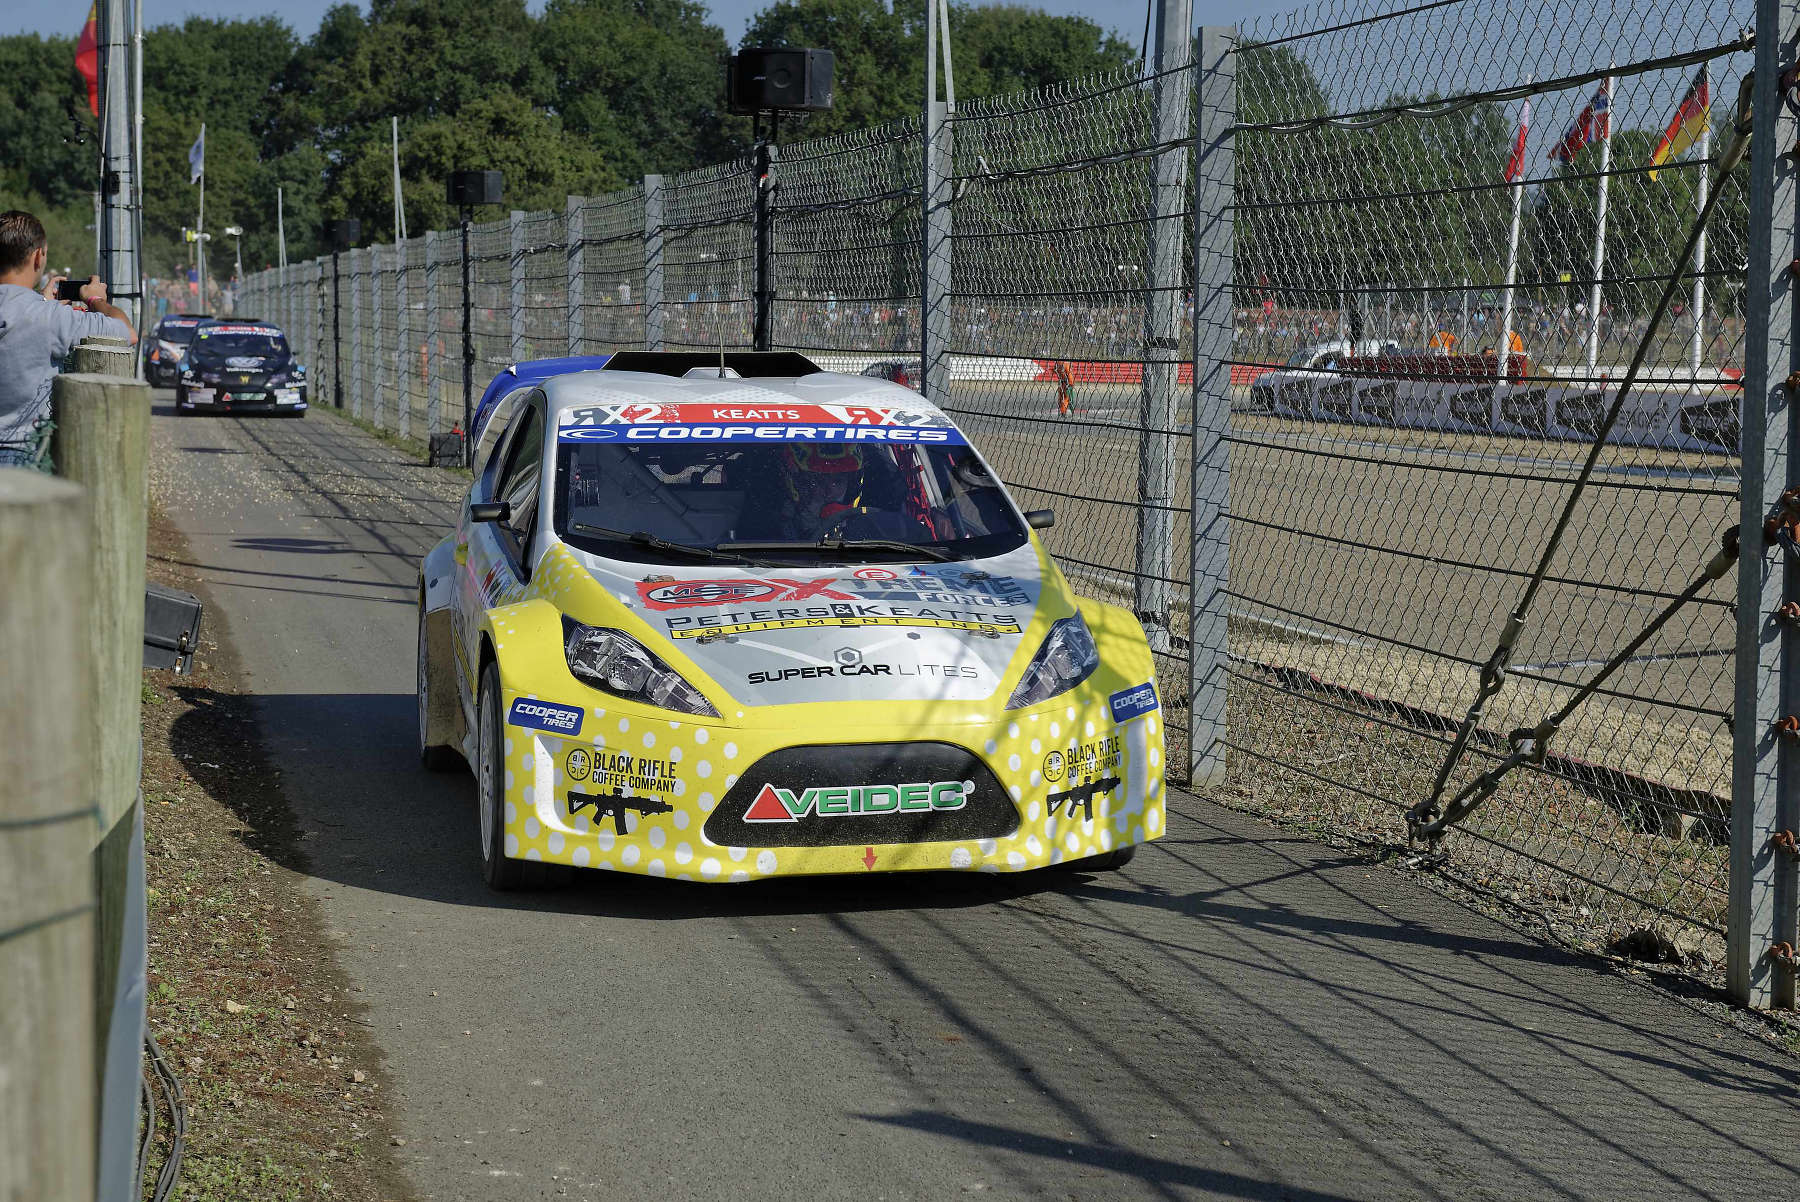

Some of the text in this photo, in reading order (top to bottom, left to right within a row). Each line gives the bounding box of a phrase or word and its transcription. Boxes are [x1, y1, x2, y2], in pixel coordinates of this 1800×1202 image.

[713, 409, 801, 419] KEATTS
[626, 426, 948, 441] COOPERTIRES
[748, 664, 979, 684] SUPER CAR LITES
[1114, 688, 1153, 709] COOPER
[1135, 698, 1154, 709] TIRES
[515, 703, 579, 722] COOPER
[543, 717, 575, 729] TIRES
[1067, 736, 1120, 765] BLACK RIFLE
[593, 752, 677, 779] BLACK RIFLE
[1067, 755, 1121, 779] COFFEE COMPANY
[592, 770, 677, 793] COFFEE COMPANY
